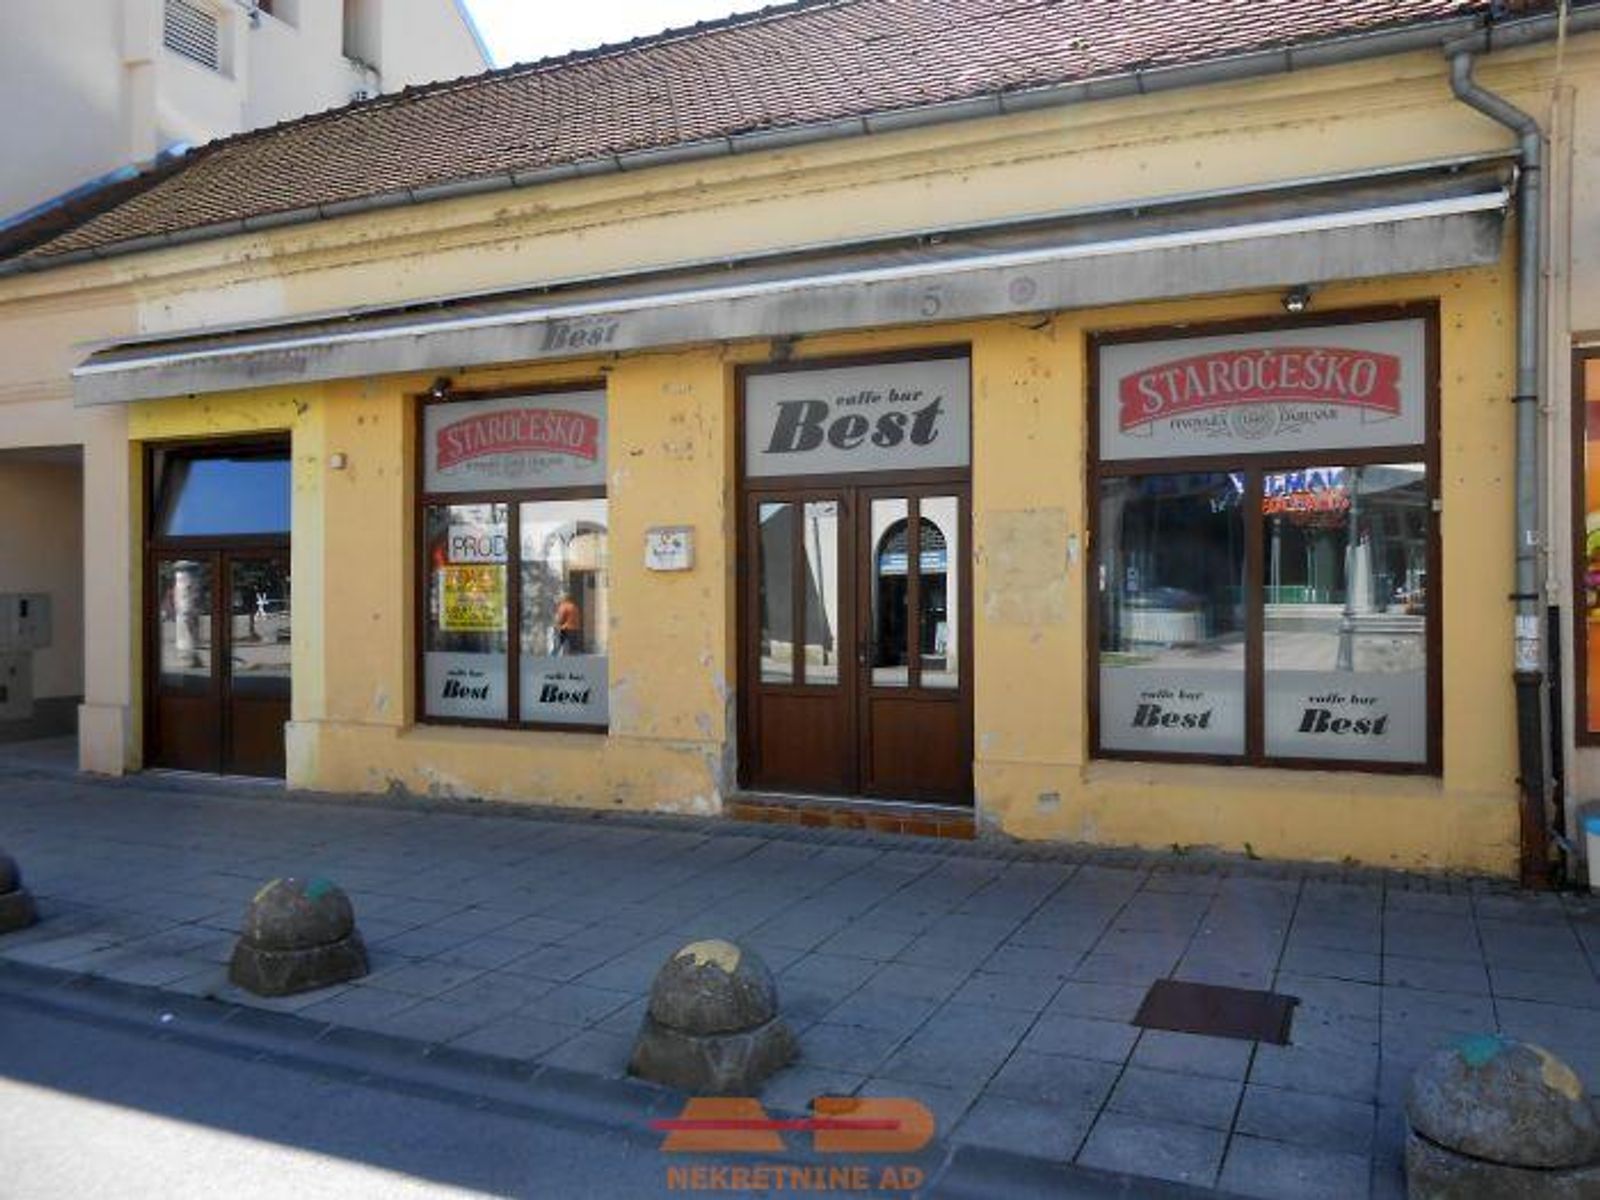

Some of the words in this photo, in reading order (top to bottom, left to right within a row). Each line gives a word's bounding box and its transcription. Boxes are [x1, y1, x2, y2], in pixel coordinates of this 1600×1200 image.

[539, 323, 619, 351] Best
[1137, 349, 1378, 414] STAROČEŠKO
[836, 390, 882, 406] caffe
[889, 388, 923, 403] bar
[446, 409, 586, 459] STAROČEŠKO
[761, 396, 945, 454] Best
[442, 679, 490, 700] Best
[539, 683, 592, 704] Best
[1132, 703, 1214, 729] Best
[1298, 708, 1390, 735] Best
